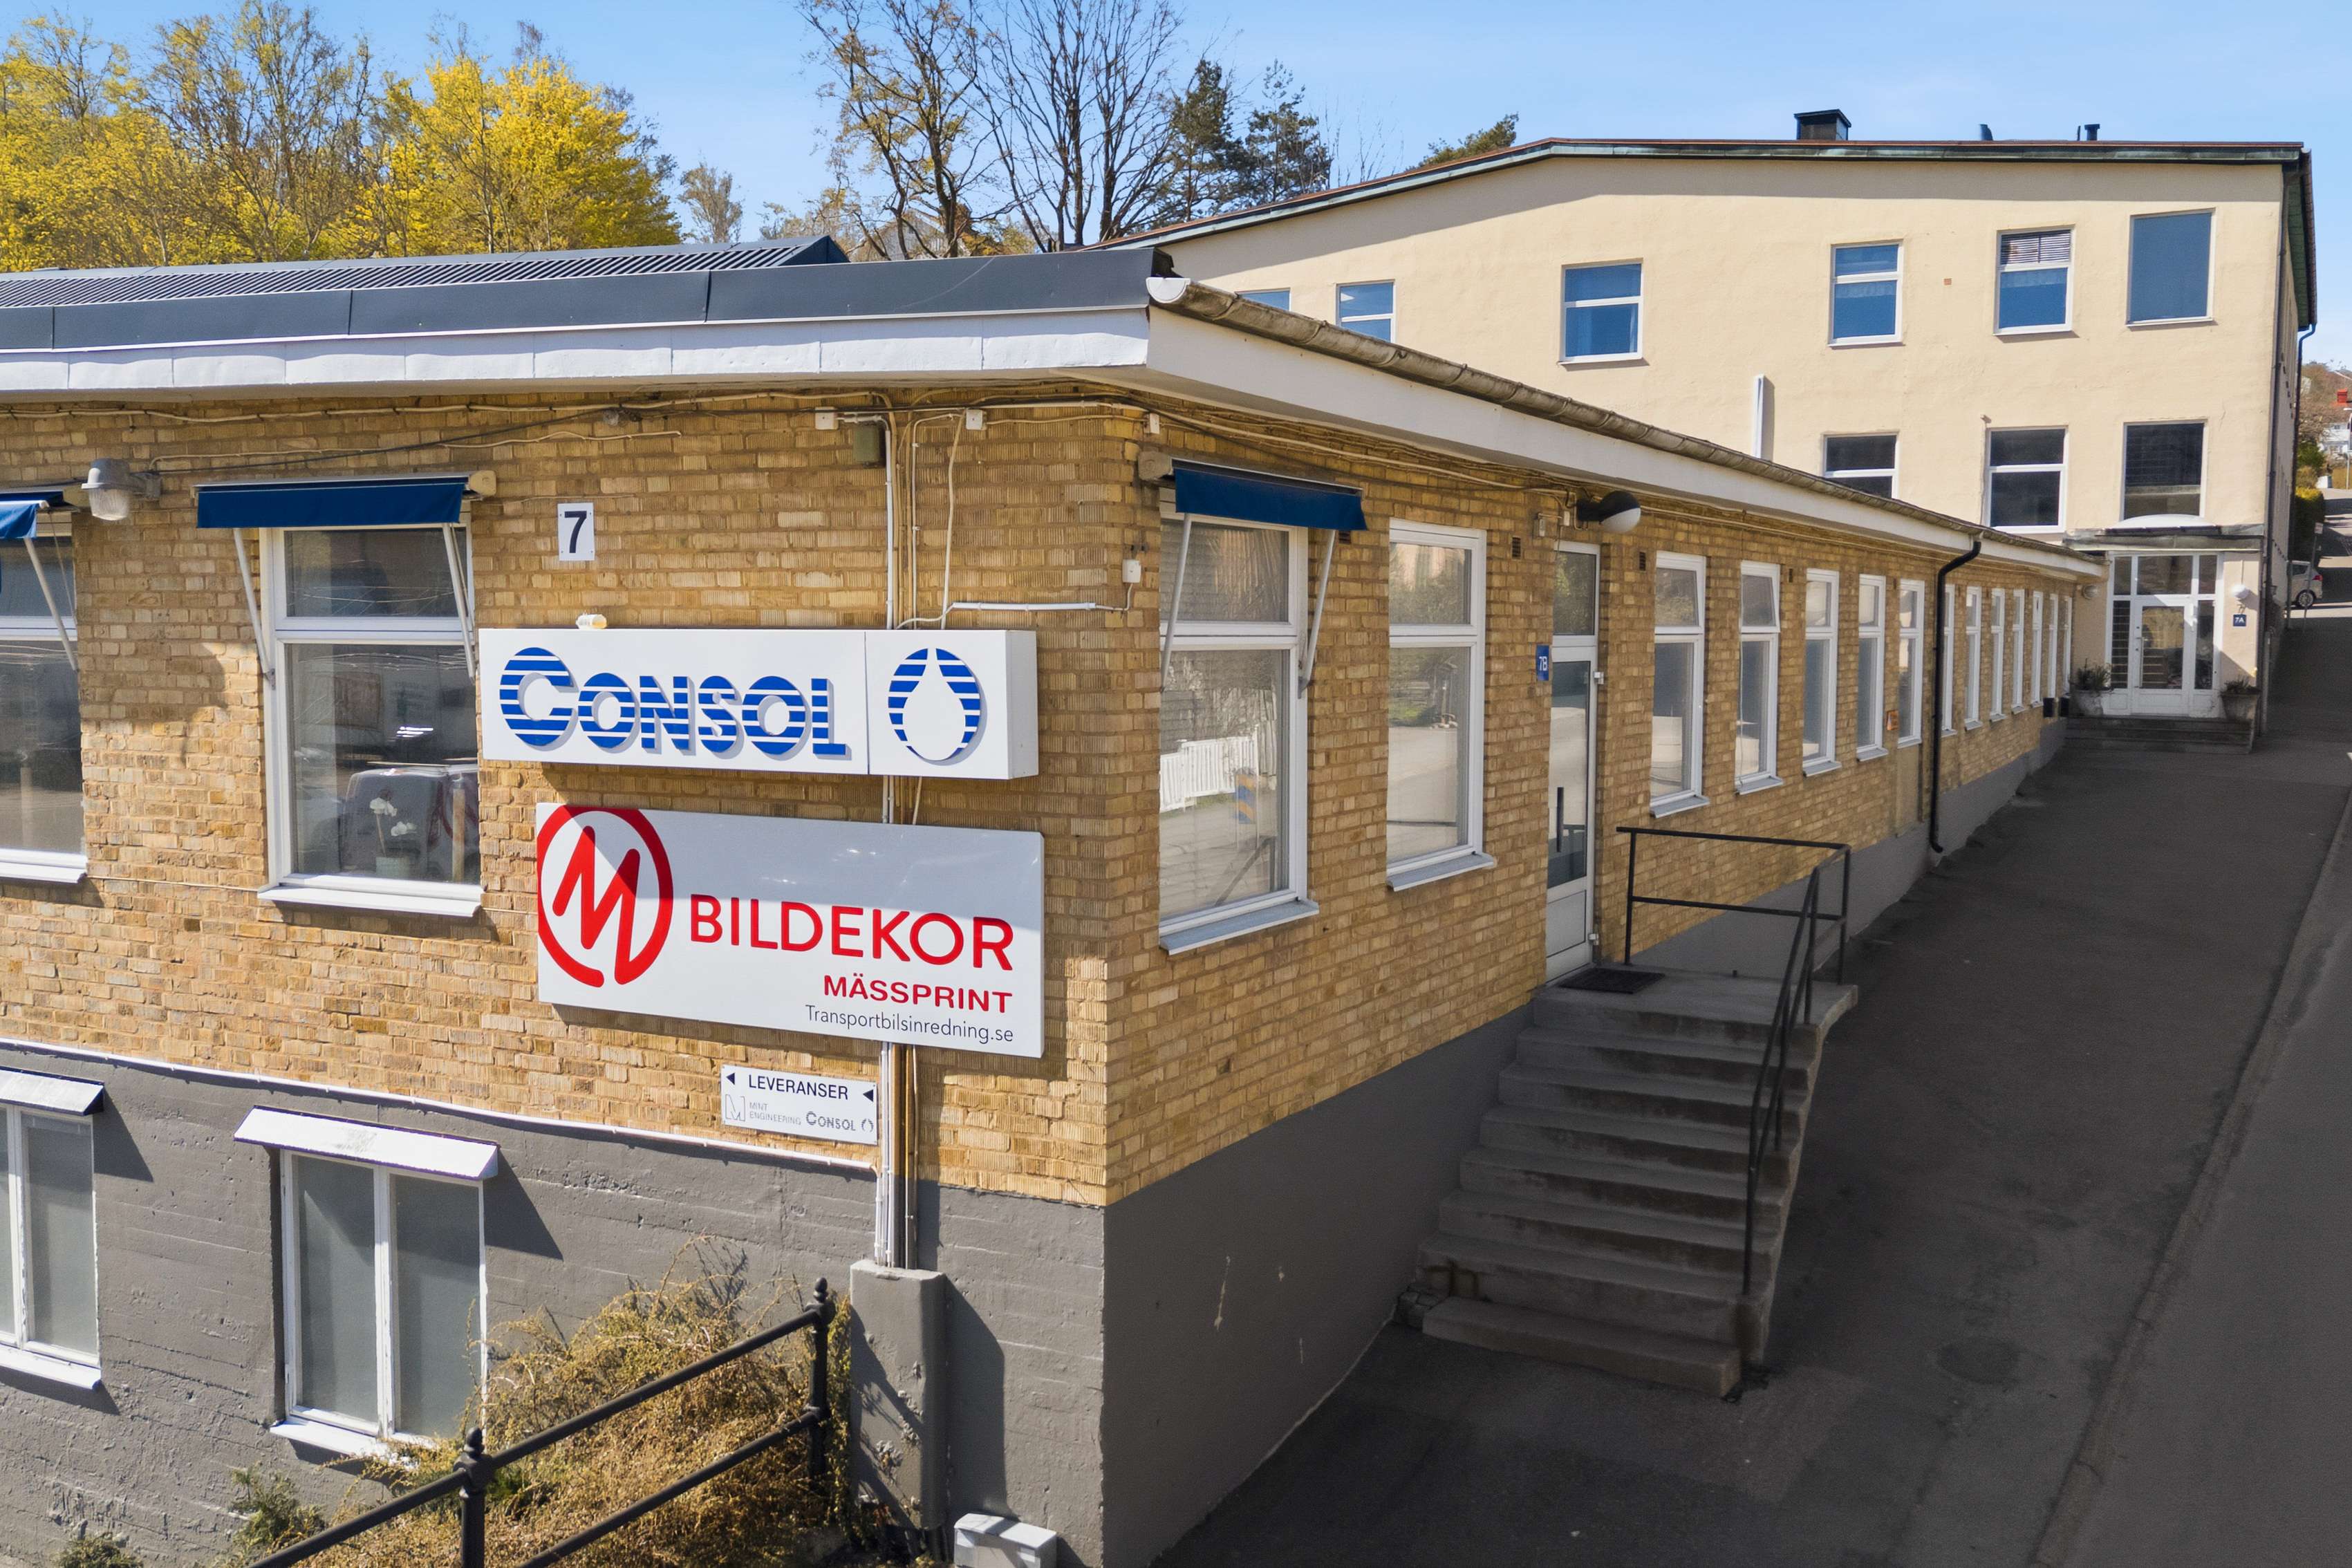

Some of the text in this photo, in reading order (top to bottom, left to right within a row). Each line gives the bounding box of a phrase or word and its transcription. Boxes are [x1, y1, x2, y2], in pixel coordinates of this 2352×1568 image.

[564, 510, 588, 554] 7
[1538, 655, 1548, 671] 7B
[499, 646, 846, 755] CONSOL
[690, 893, 1014, 971] BILDEKOR
[823, 972, 1013, 1014] MÄSSPRINT
[805, 1004, 1014, 1045] Transportbilsinredning.se
[748, 1074, 849, 1101] LEVERANSER
[749, 1101, 769, 1111] MINT
[749, 1111, 802, 1126] ENGINEERING
[805, 1110, 857, 1131] CONSOL
